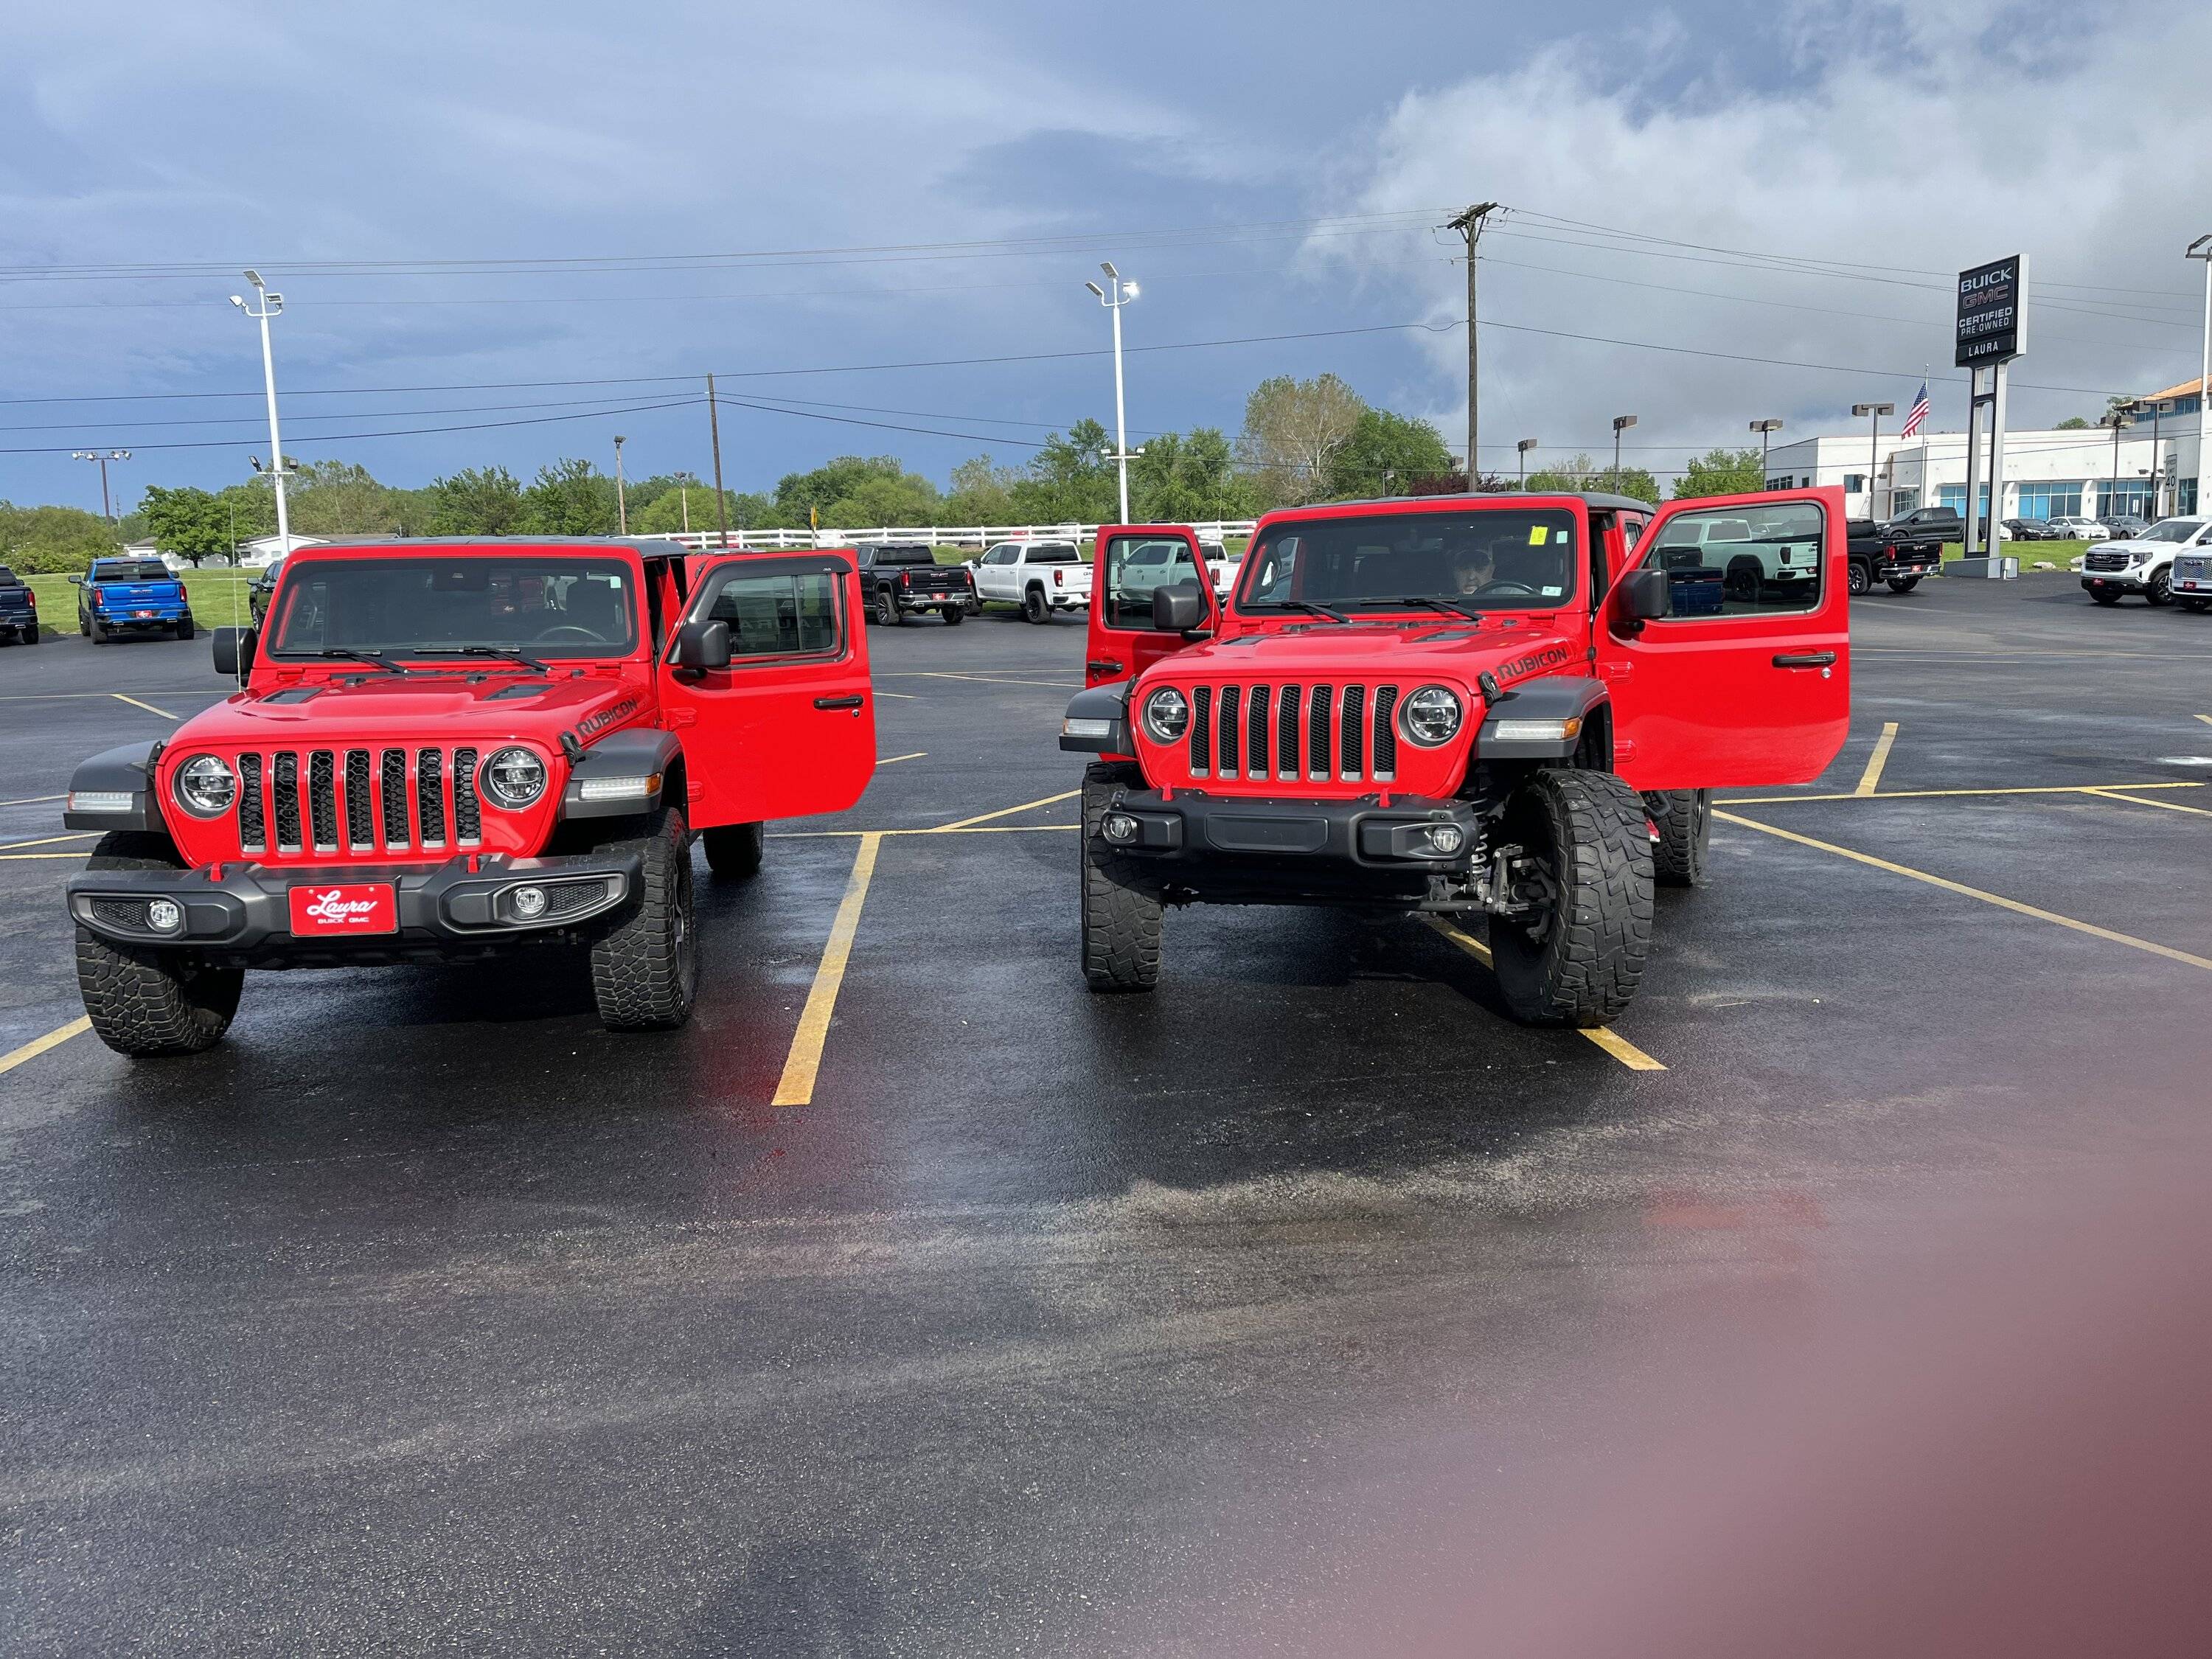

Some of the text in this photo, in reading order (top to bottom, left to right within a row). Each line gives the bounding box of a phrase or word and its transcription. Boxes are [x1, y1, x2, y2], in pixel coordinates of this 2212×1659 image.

[1961, 267, 2013, 293] BUICK
[1963, 285, 2008, 310] GMC
[1958, 306, 2013, 328] CERTIFIED
[1961, 317, 2010, 336] PRE-OWNED
[1968, 341, 1999, 357] LAURA
[2166, 475, 2176, 487] 40
[1497, 647, 1568, 679] RUBICON
[576, 697, 639, 737] RUBICON
[306, 889, 378, 919] Laura
